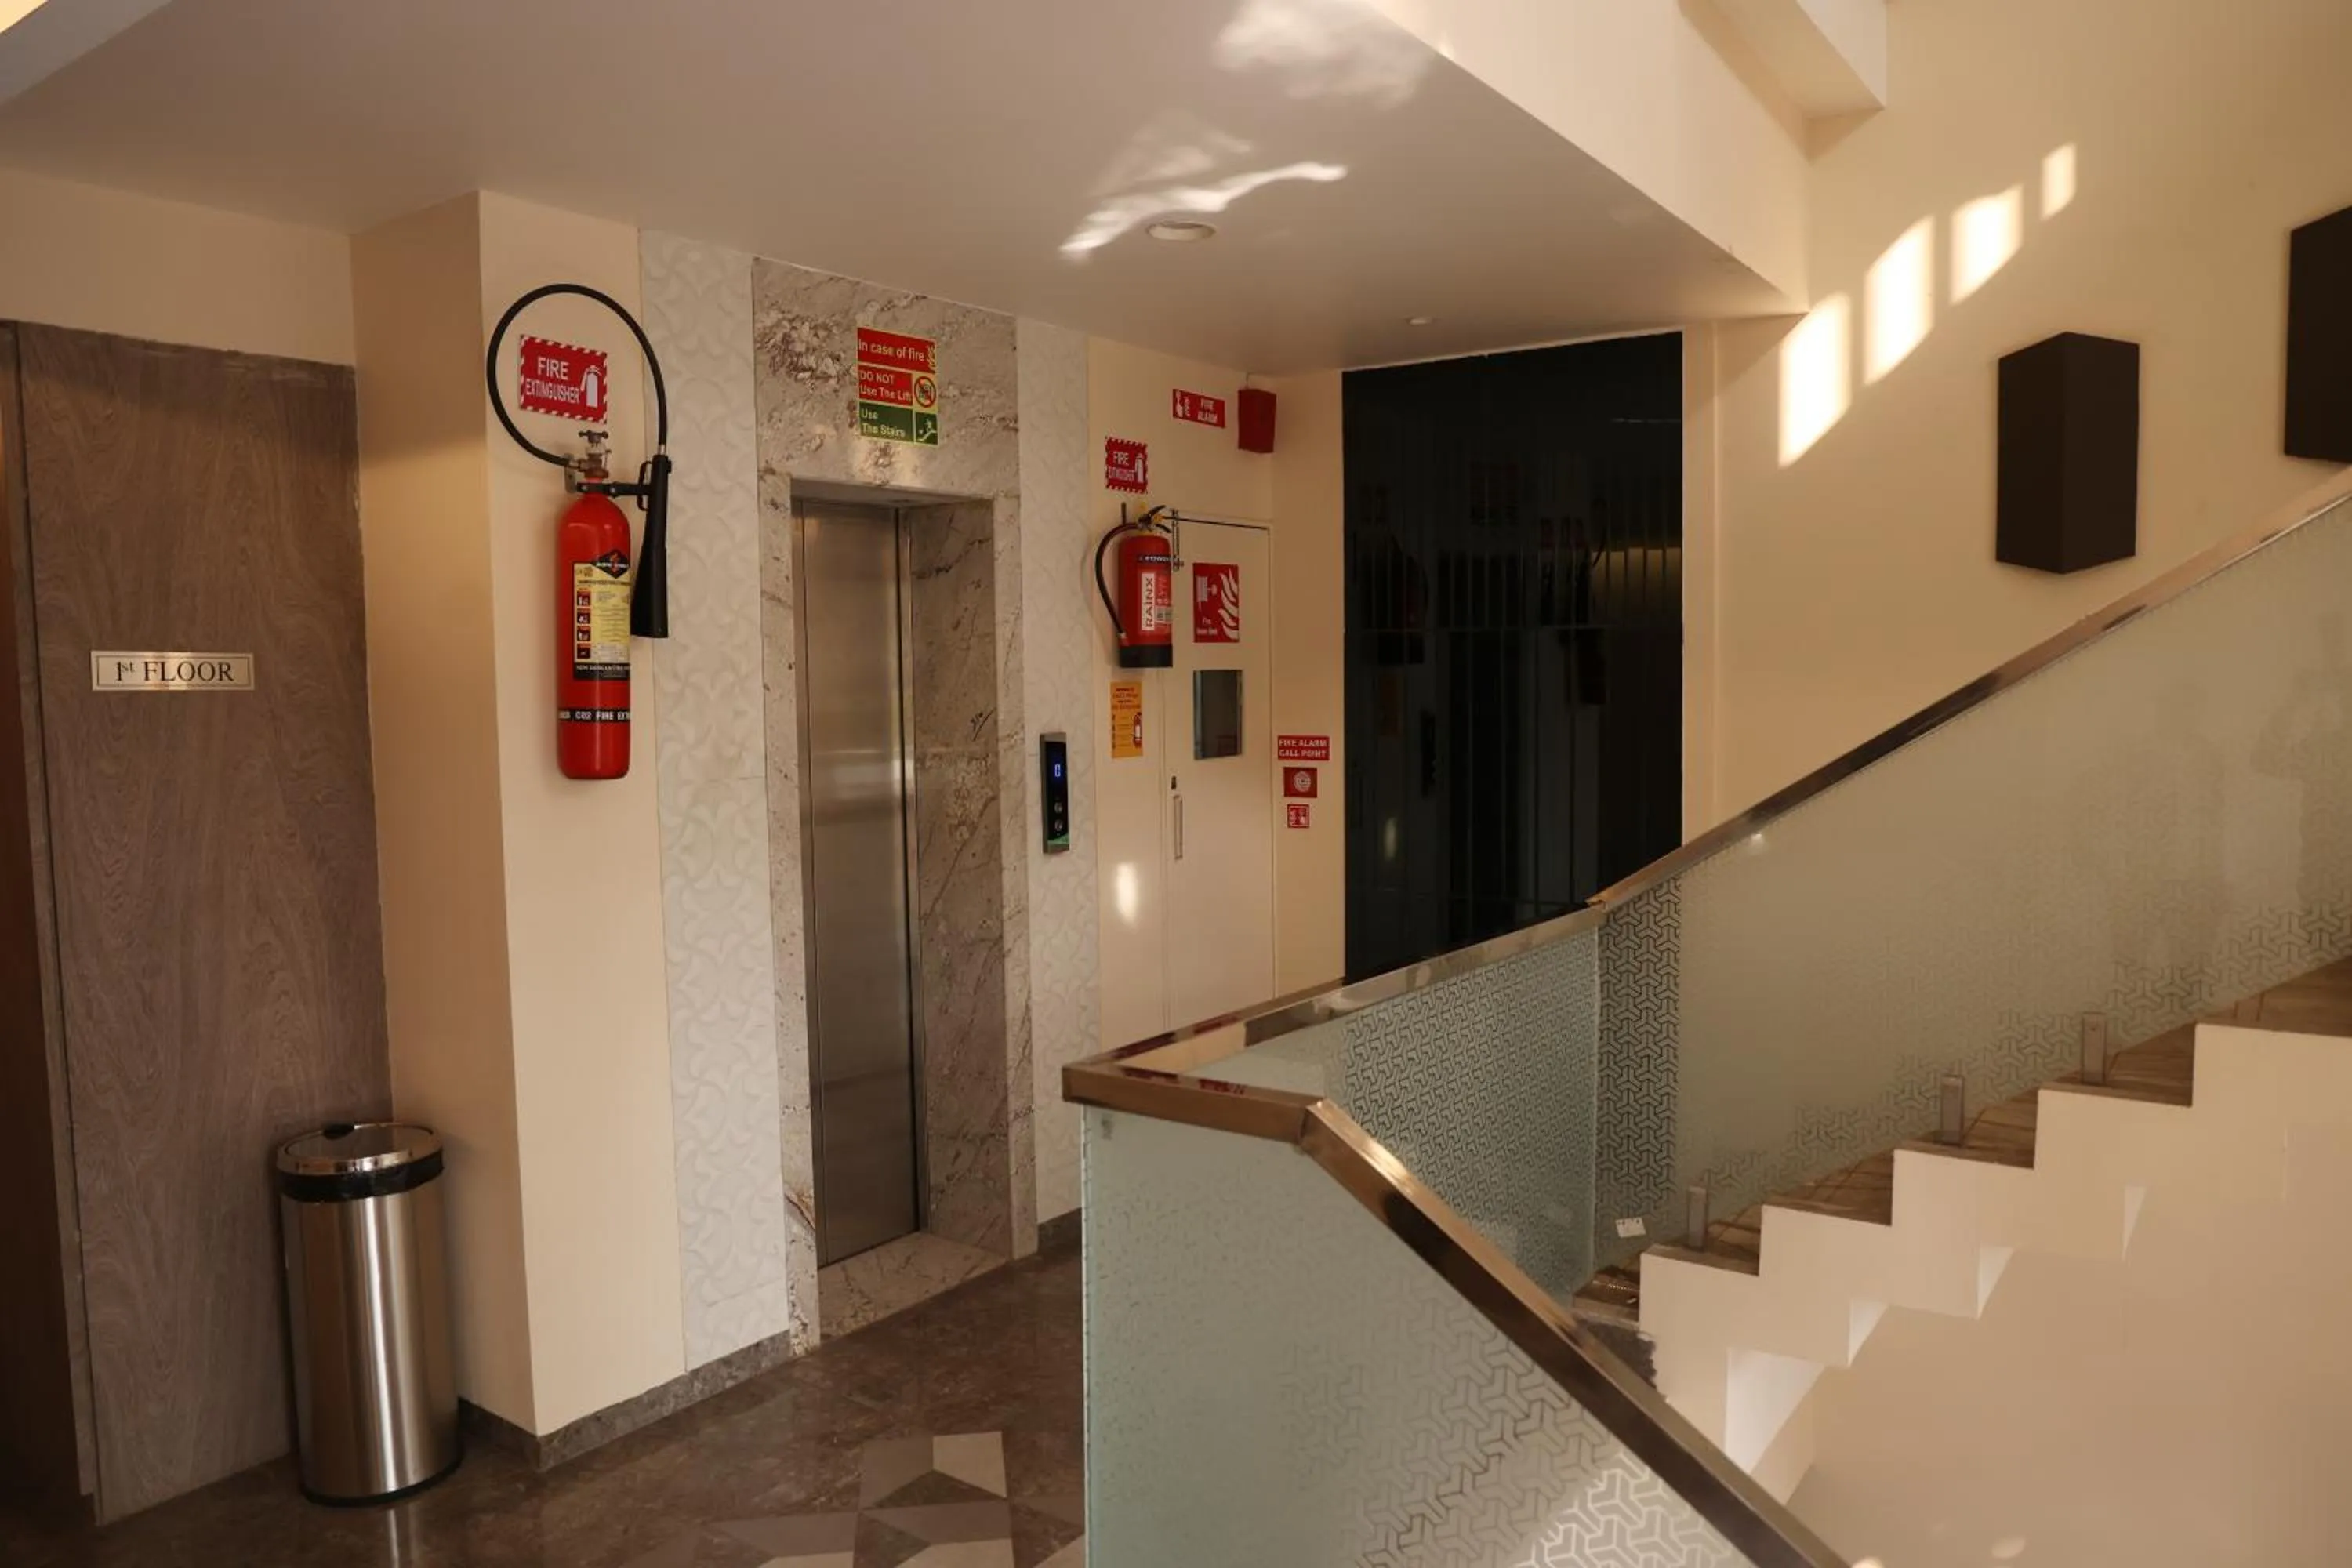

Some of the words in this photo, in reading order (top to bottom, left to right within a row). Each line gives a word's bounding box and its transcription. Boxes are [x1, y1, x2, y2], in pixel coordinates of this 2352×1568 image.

[858, 338, 868, 352] In
[870, 343, 894, 354] case
[896, 346, 906, 358] of
[909, 347, 925, 361] fire
[536, 356, 570, 381] FIRE
[859, 369, 874, 382] DO
[876, 373, 895, 385] NOT
[860, 383, 877, 396] Use
[880, 387, 895, 399] The
[898, 390, 912, 402] Lift
[862, 408, 879, 420] Use
[863, 423, 879, 434] The
[880, 424, 906, 438] Stairs
[1113, 451, 1130, 466] FIRE
[116, 661, 136, 681] 1st
[143, 661, 234, 682] FLOOR
[596, 710, 614, 720] FIRE
[1299, 739, 1328, 748] ALARM
